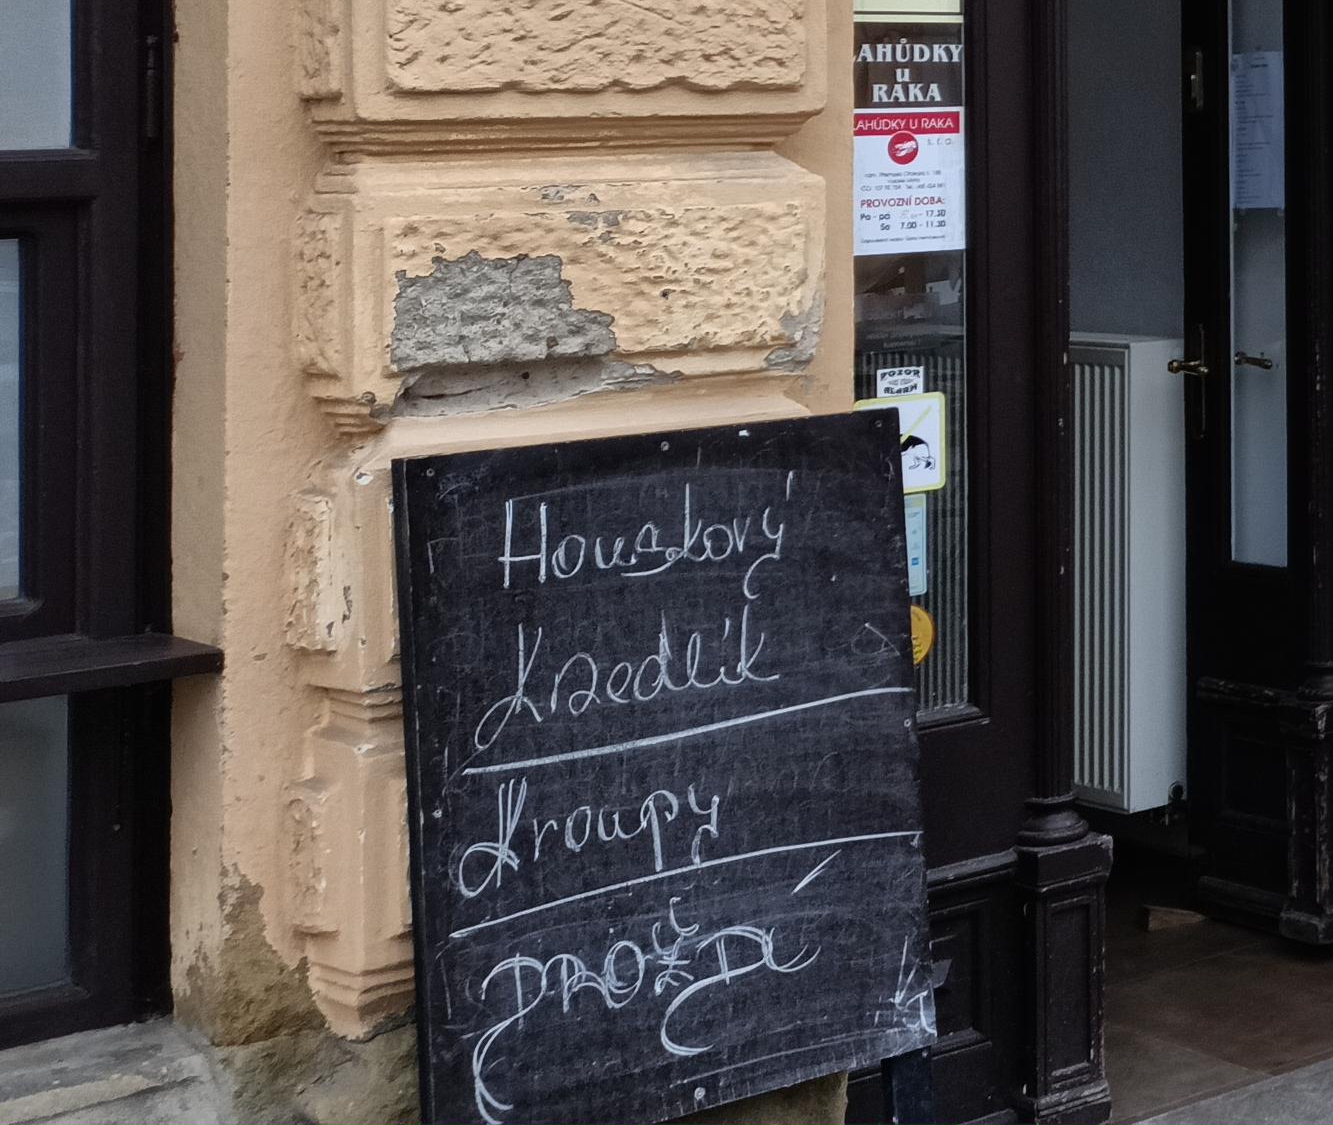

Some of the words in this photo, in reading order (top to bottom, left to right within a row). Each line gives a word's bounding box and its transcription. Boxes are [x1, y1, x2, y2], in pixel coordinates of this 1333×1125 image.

[854, 38, 963, 63] AHŮDKY
[872, 83, 942, 103] RAKA
[909, 119, 919, 130] U
[921, 117, 954, 130] RAKA
[860, 195, 912, 208] PROVOZNÍ
[914, 196, 945, 206] DOBA:
[456, 775, 720, 898] Kroupy
